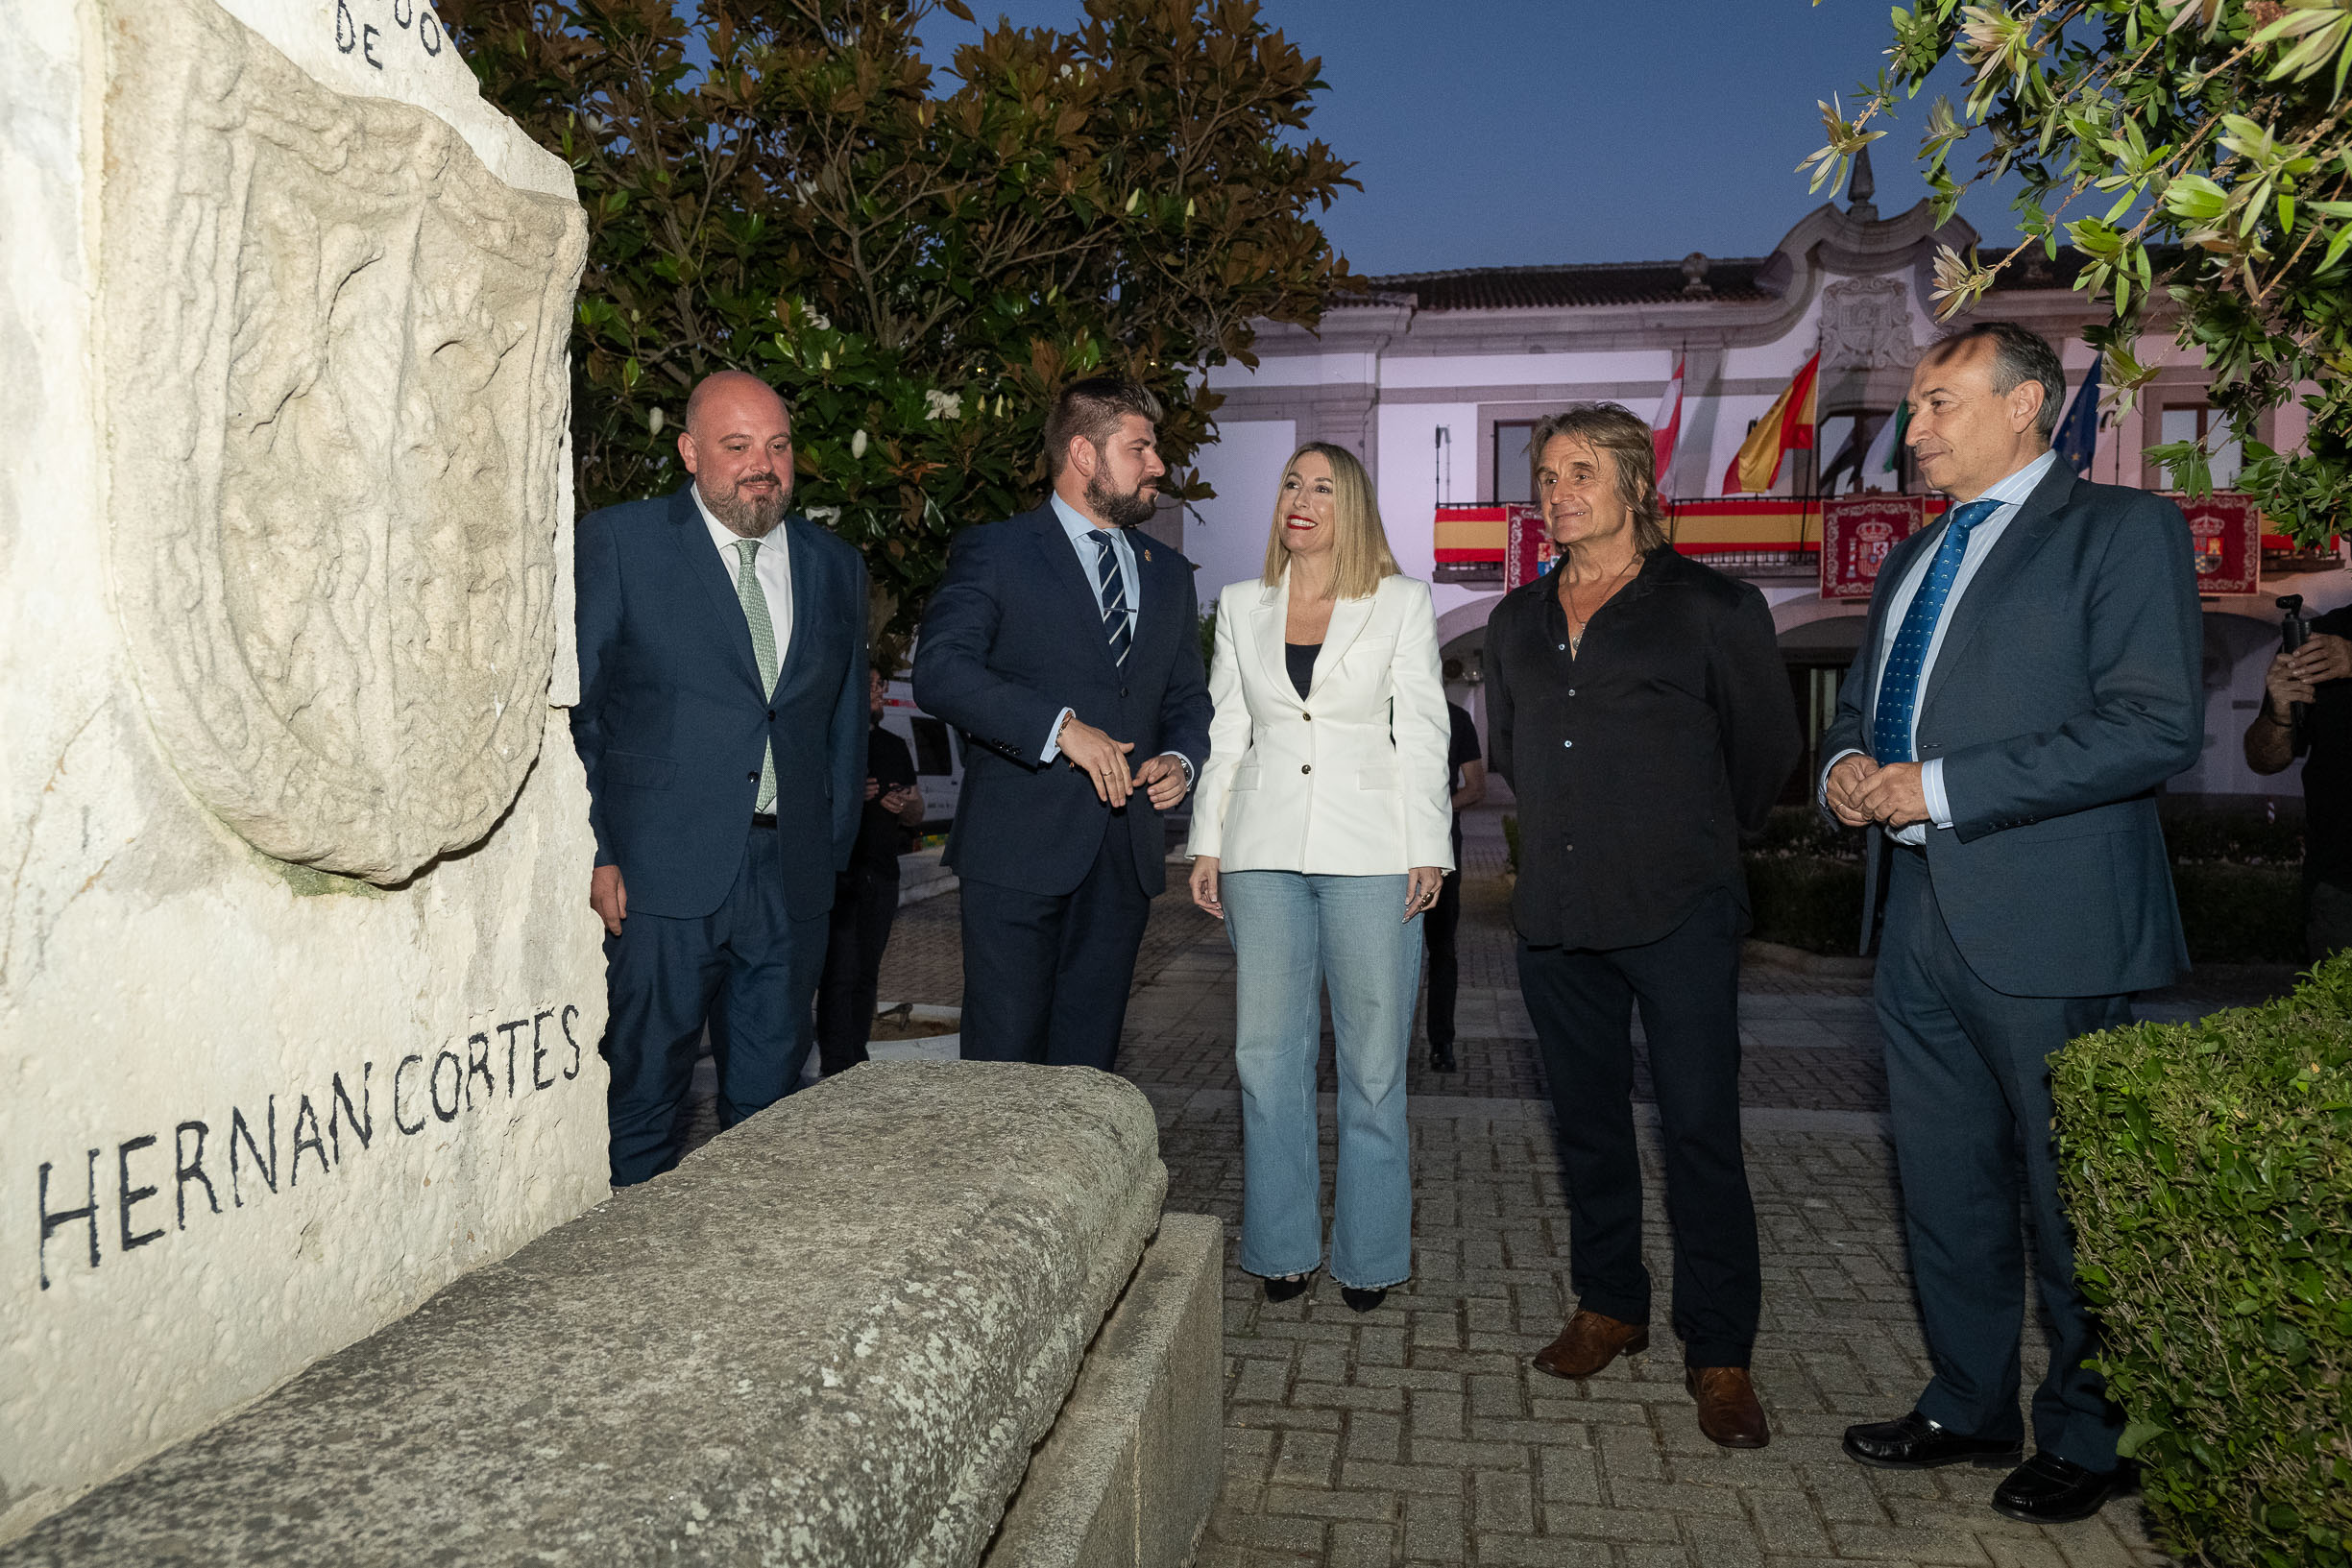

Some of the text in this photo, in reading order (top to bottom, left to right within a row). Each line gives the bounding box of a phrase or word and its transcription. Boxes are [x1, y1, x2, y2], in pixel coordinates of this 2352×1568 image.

[336, 0, 383, 70] DE
[38, 1004, 581, 1291] HERNAN CORTES
